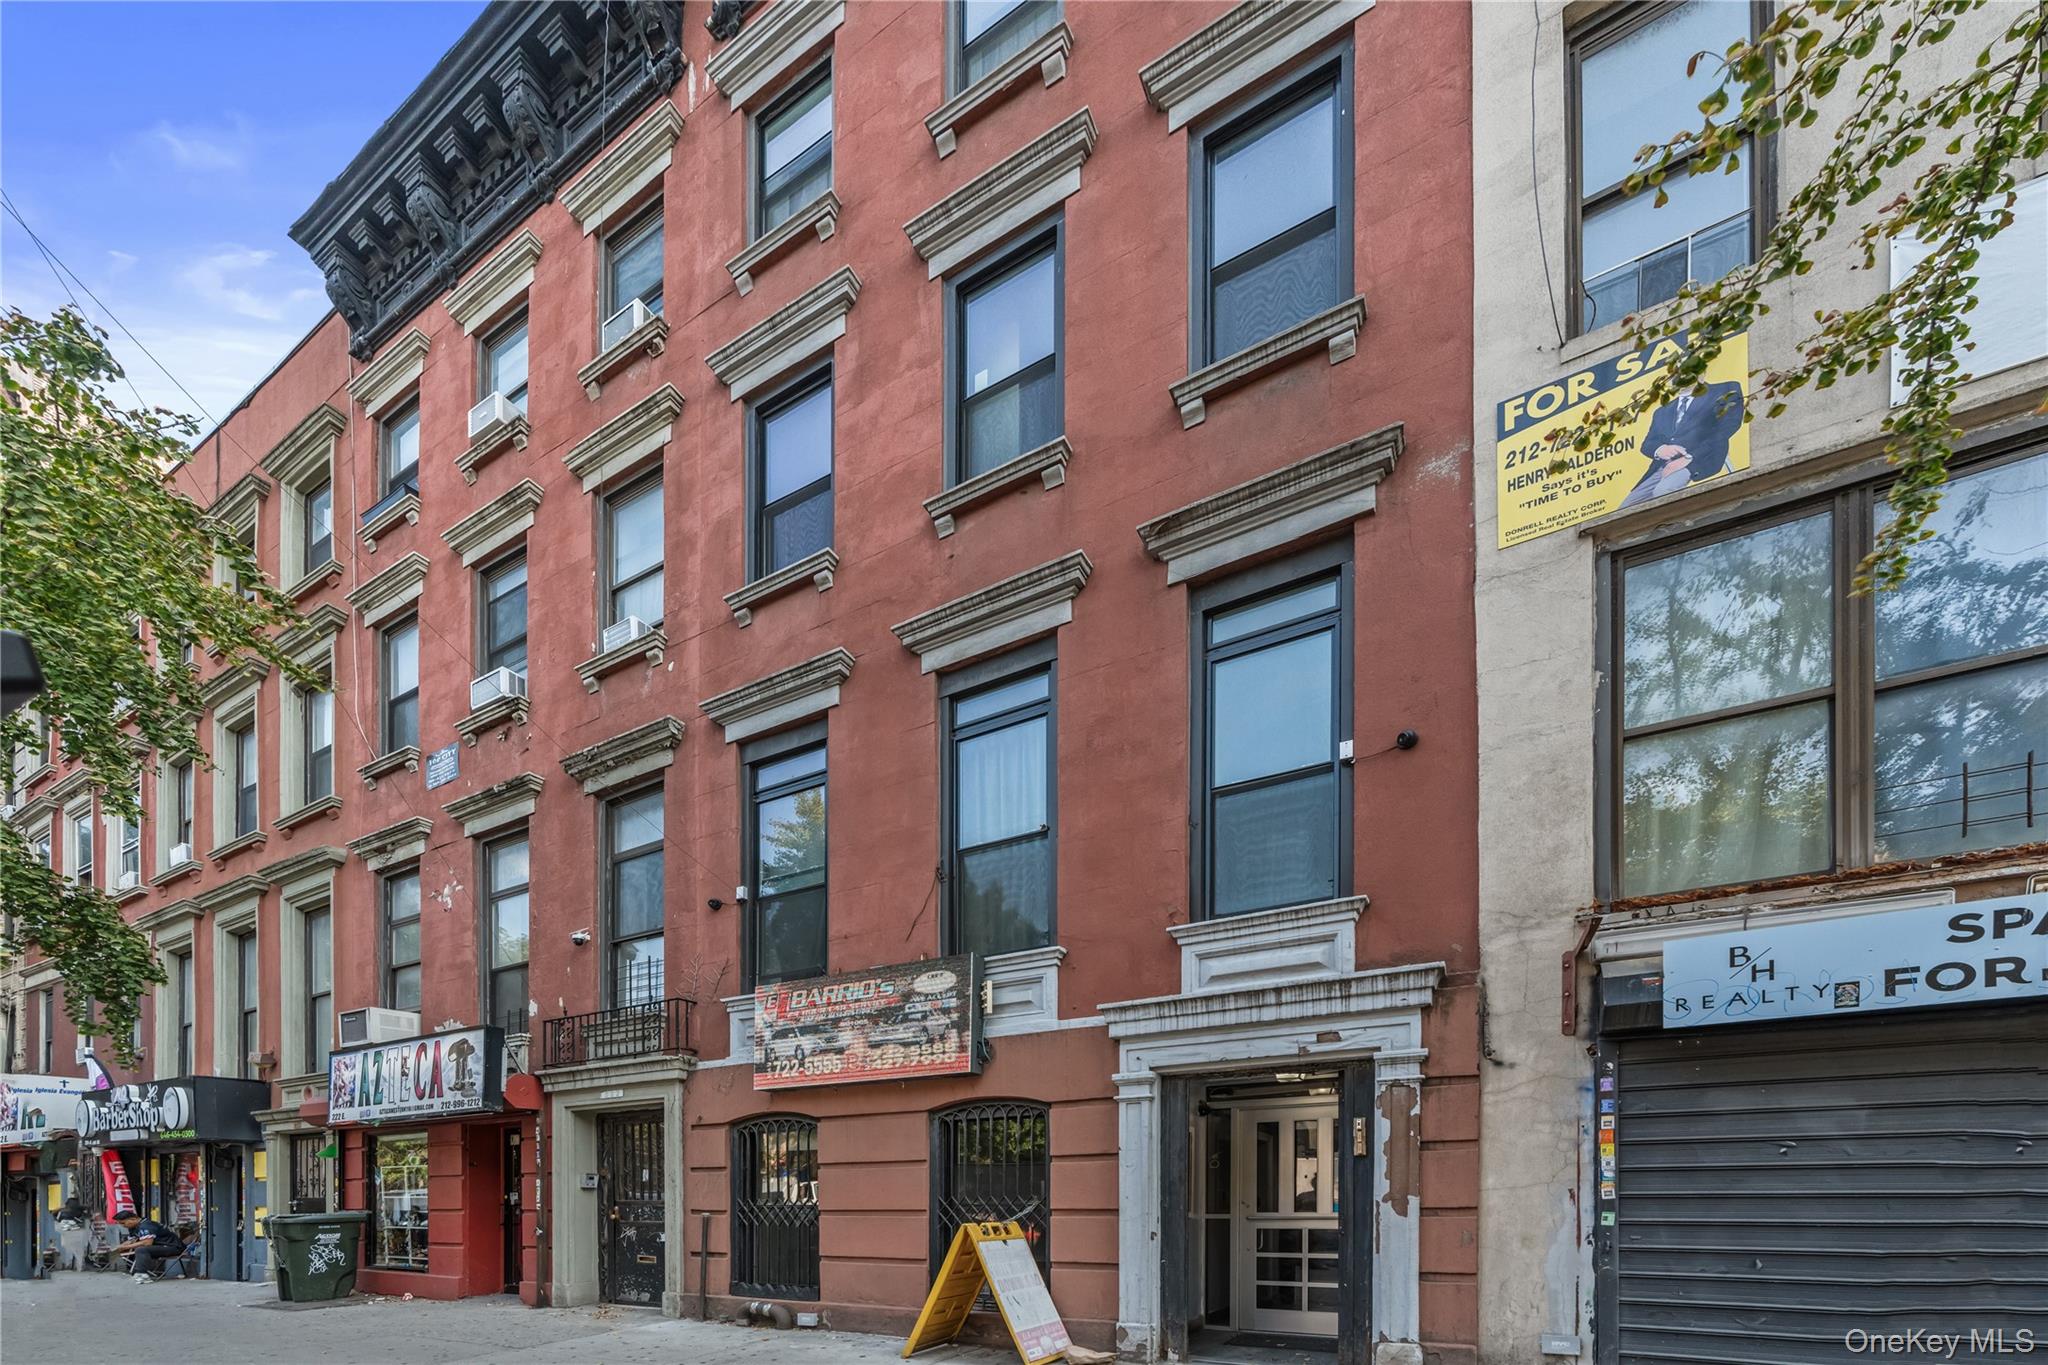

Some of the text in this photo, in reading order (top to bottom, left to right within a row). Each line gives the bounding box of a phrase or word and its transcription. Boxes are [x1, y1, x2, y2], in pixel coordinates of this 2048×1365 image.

[1504, 371, 1598, 432] FOR
[1507, 436, 1635, 493] HENRY ALDERON
[1541, 468, 1598, 493] Says it's
[1519, 469, 1622, 509] "TIME TO BUY"
[1504, 520, 1544, 537] DONRELL
[1546, 508, 1579, 522] REALTY
[1581, 506, 1606, 518] Broker
[1884, 956, 2032, 997] FOR
[1675, 983, 1830, 1012] REALTY
[358, 1040, 443, 1107] AZTECA
